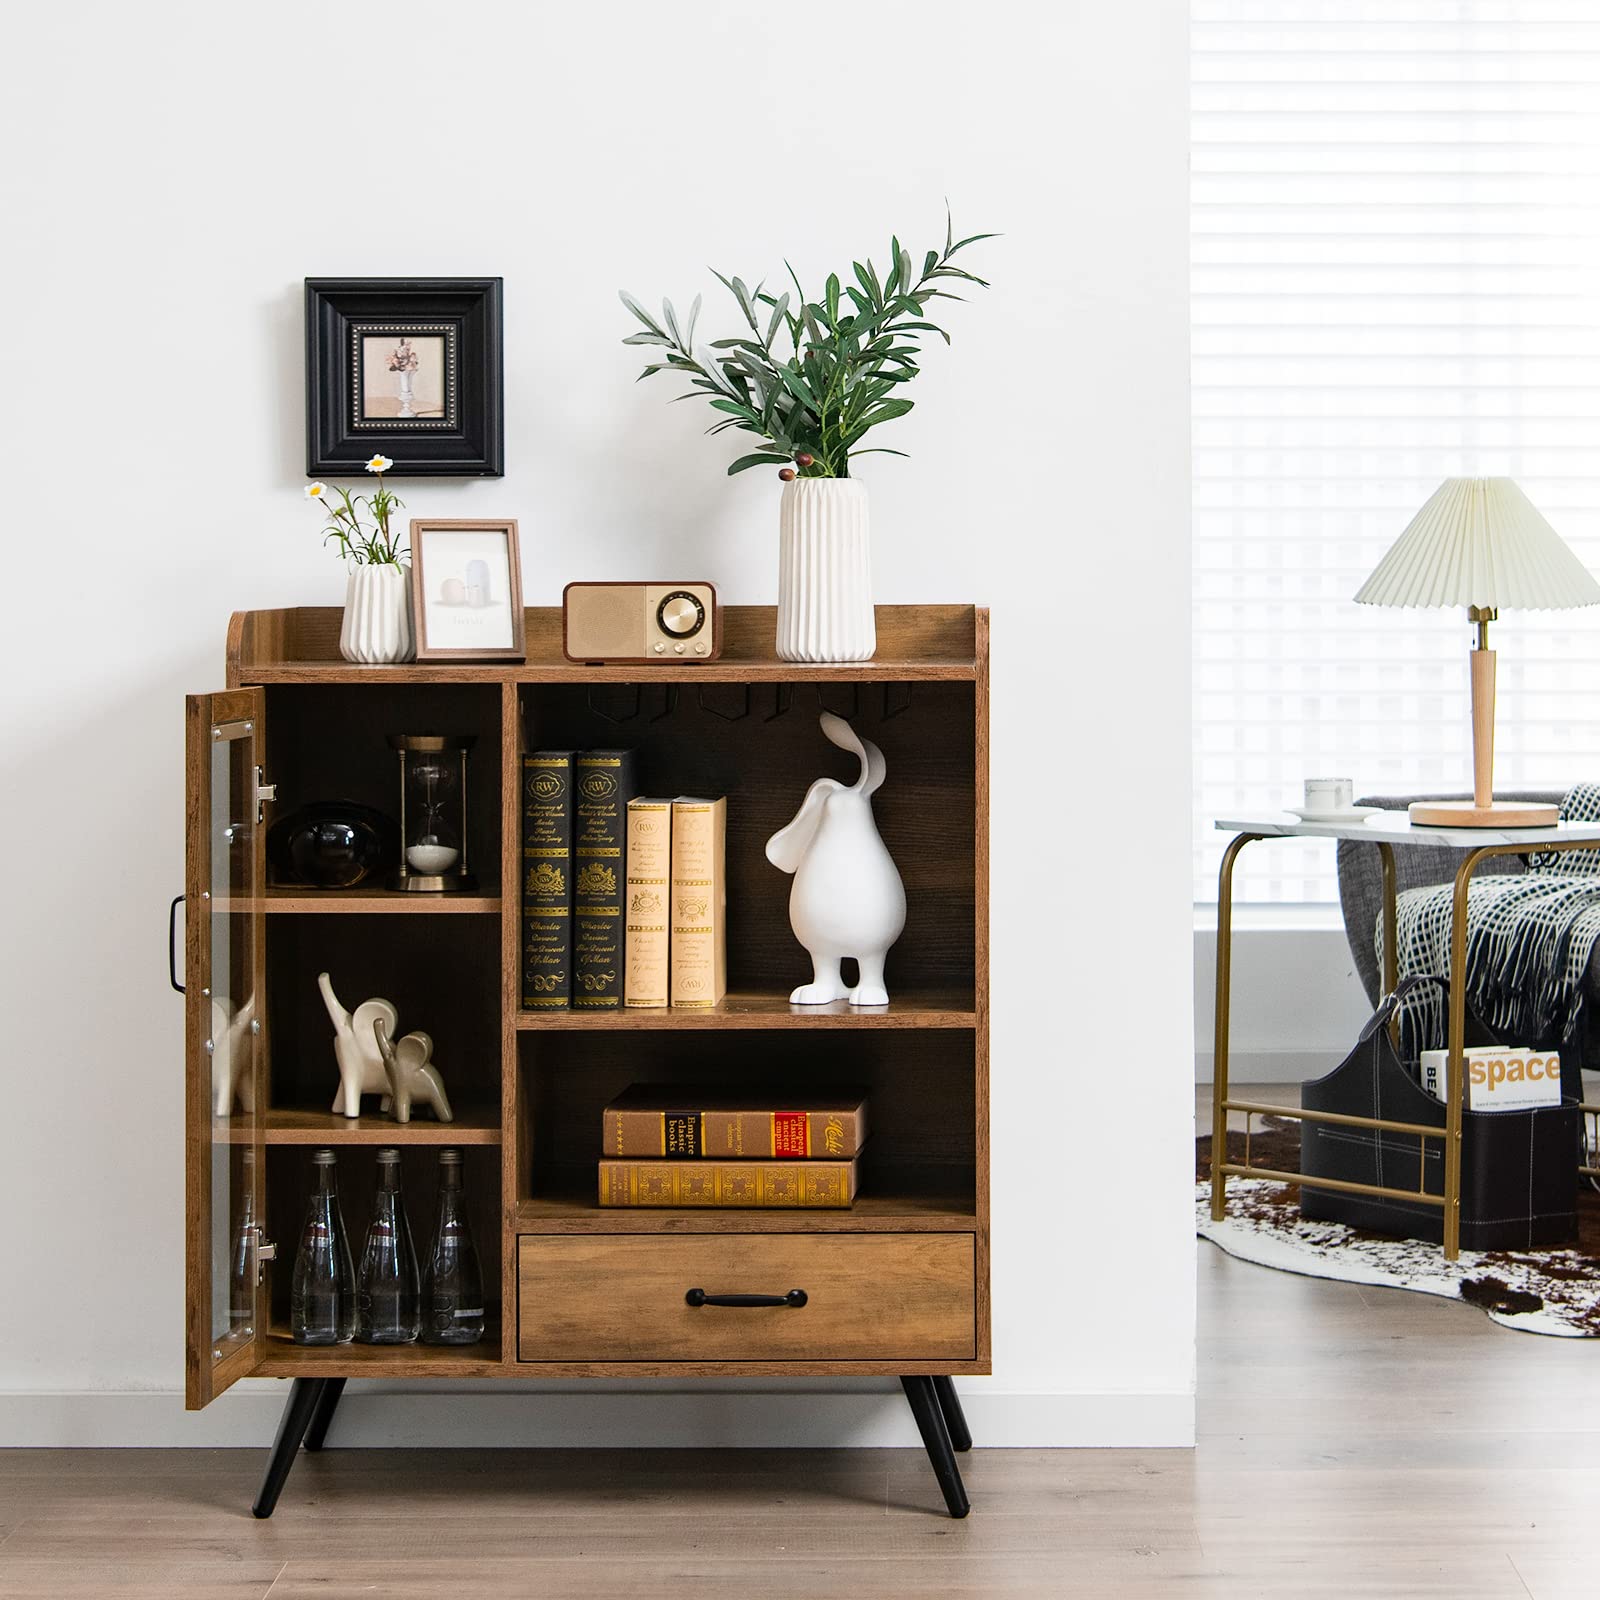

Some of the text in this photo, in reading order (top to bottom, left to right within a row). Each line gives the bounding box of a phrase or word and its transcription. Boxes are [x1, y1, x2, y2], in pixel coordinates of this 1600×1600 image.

[535, 781, 554, 792] RW
[587, 781, 607, 792] RW
[638, 823, 655, 832] RW
[1470, 1055, 1560, 1092] space
[668, 1120, 678, 1152] books
[678, 1119, 686, 1152] classic
[686, 1116, 697, 1155] Empire
[774, 1121, 784, 1150] empire
[790, 1119, 799, 1153] classical
[795, 1115, 806, 1156] European
